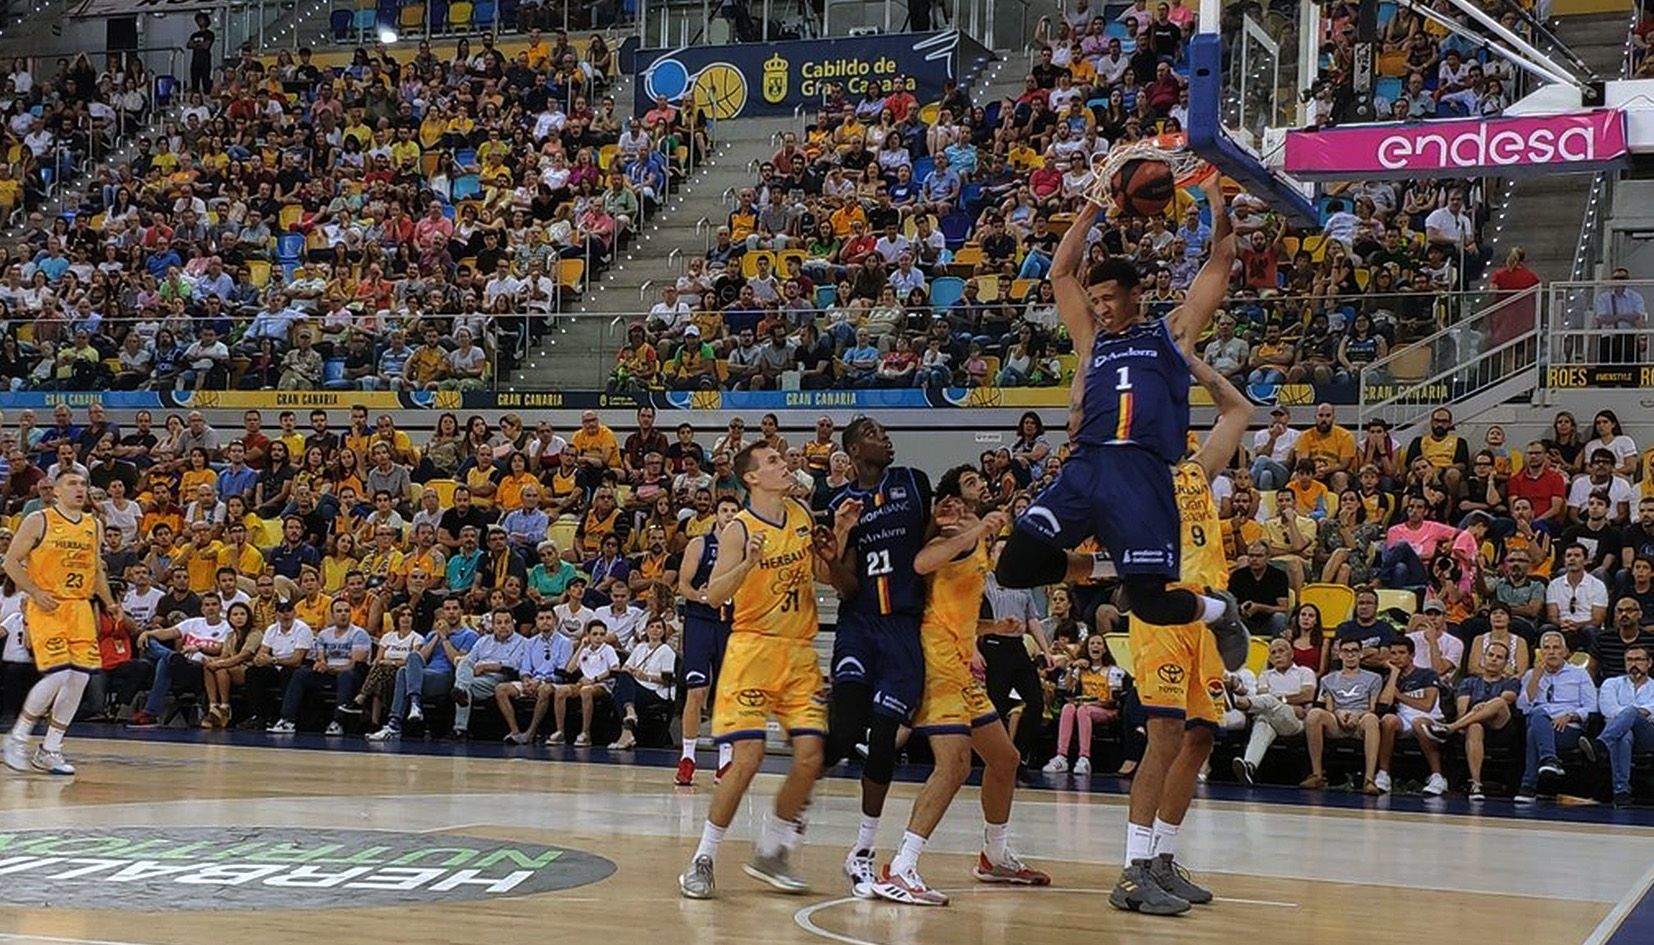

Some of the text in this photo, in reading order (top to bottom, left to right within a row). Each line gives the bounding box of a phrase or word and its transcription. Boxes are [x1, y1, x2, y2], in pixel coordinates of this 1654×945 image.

[801, 56, 897, 79] Cabildo de
[1377, 122, 1595, 170] endesa
[1115, 366, 1133, 390] 1
[276, 393, 338, 406] GRAN CANARIA
[497, 393, 563, 406] GRAN CANARIA
[786, 392, 857, 406] GRAN CANARIA
[1190, 524, 1206, 548] 9
[866, 548, 894, 576] 21
[65, 572, 85, 589] 23
